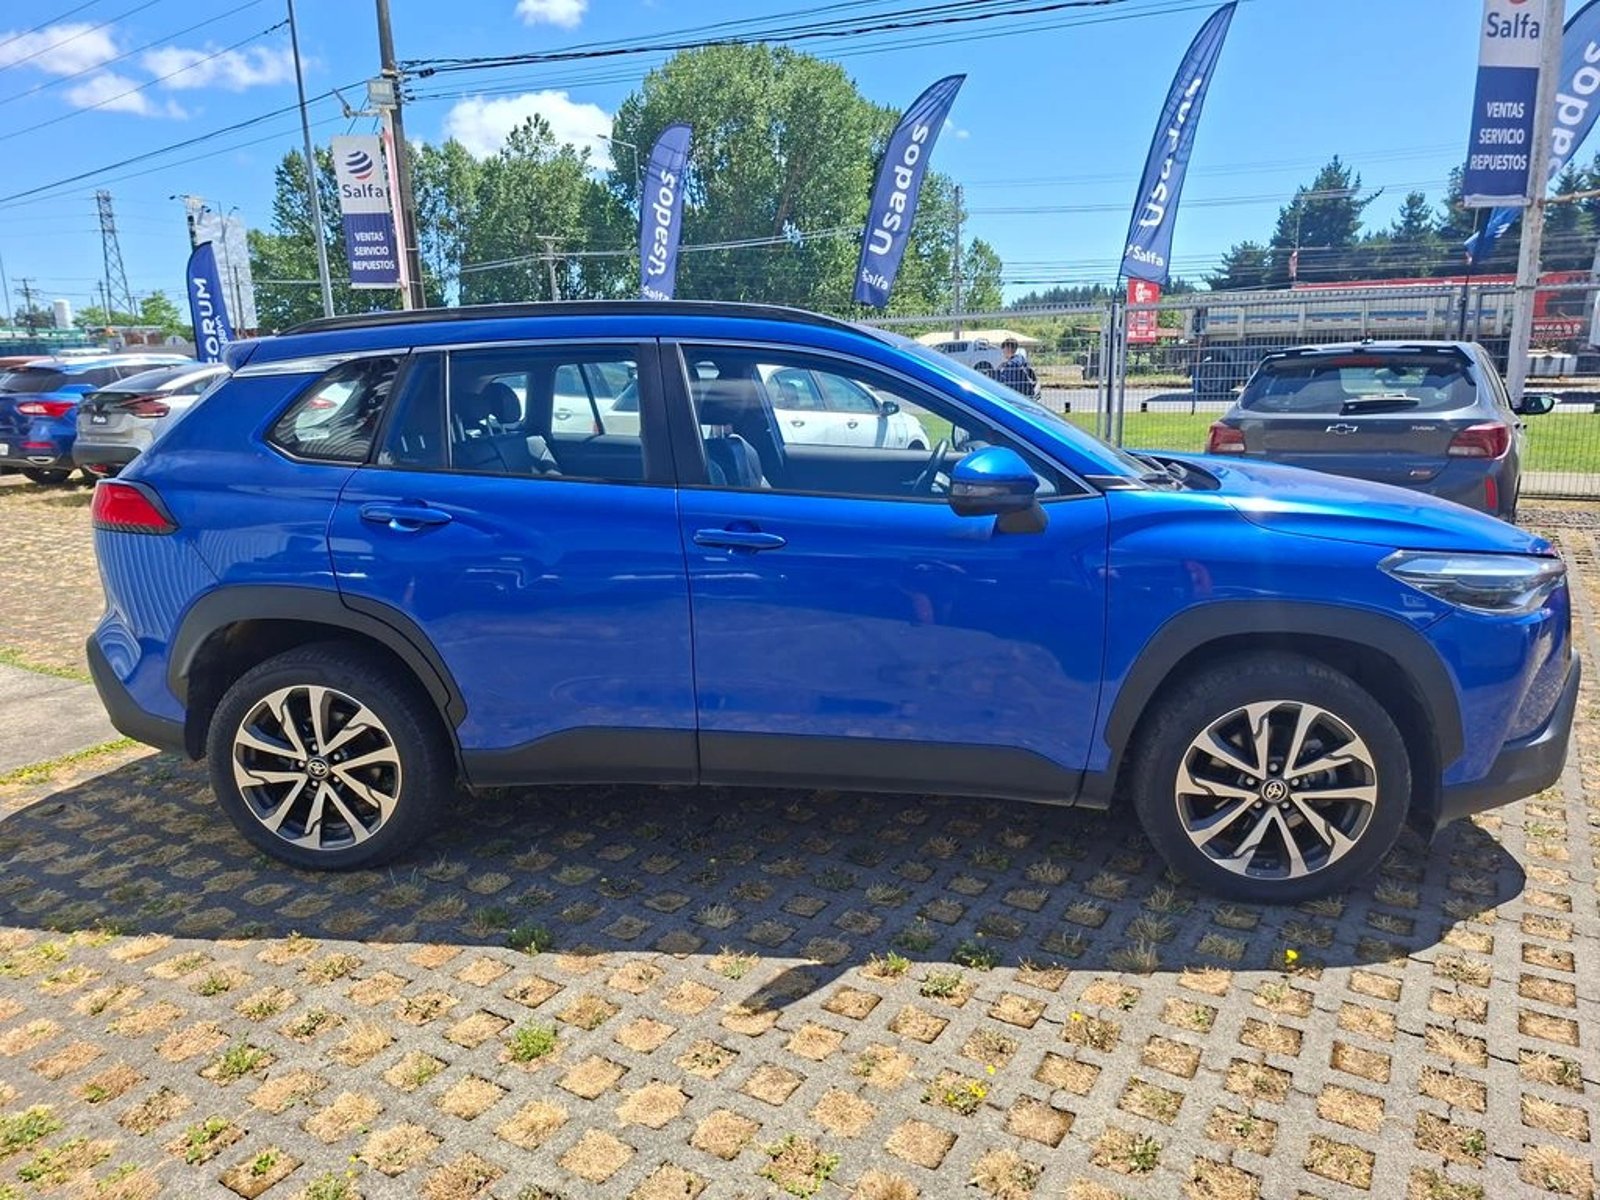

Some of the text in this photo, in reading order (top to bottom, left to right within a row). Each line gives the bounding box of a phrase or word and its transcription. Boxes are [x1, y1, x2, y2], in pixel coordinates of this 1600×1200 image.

[1487, 12, 1540, 39] Salfa
[1486, 102, 1525, 119] VENTAS
[1479, 128, 1525, 145] SERVICIO
[1469, 154, 1527, 171] REPUESTOS
[342, 183, 384, 198] Salfa
[868, 123, 929, 256] Usados
[647, 169, 676, 276] Usados
[354, 232, 384, 242] VENTAS
[354, 246, 389, 256] SERVICIO
[1132, 245, 1164, 266] Salfa
[352, 260, 395, 271] REPUESTOS
